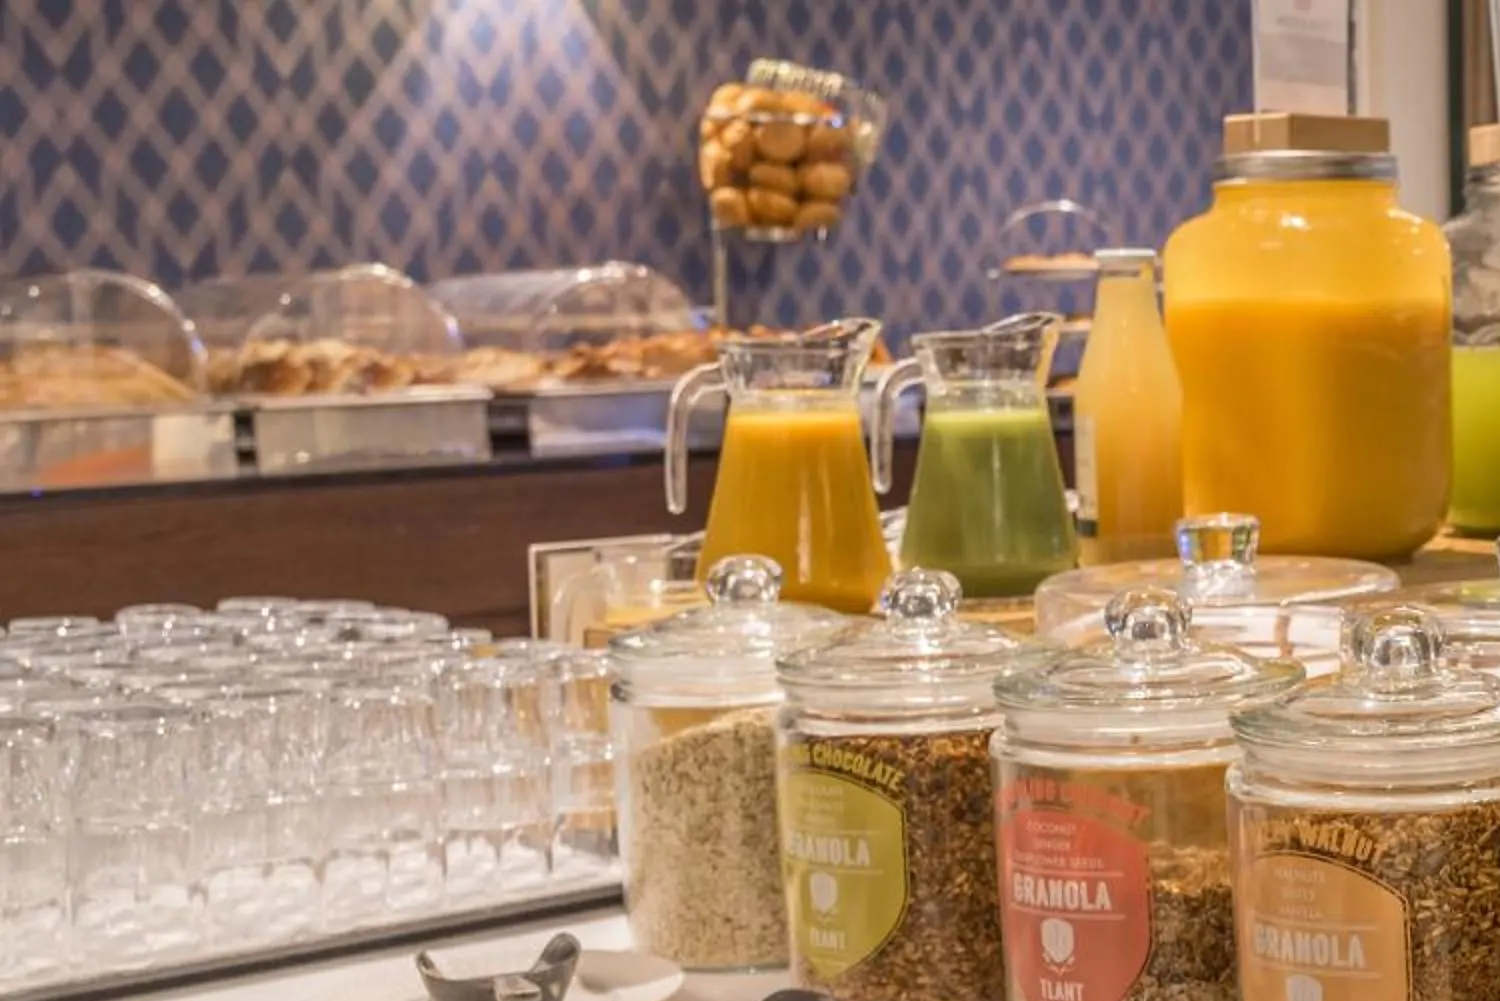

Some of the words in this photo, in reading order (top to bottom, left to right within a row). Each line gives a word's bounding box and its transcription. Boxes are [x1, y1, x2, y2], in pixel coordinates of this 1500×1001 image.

[813, 743, 905, 790] CHOCOLATE
[1013, 872, 1114, 912] GRANOLA
[1253, 923, 1368, 970] GRANOLA
